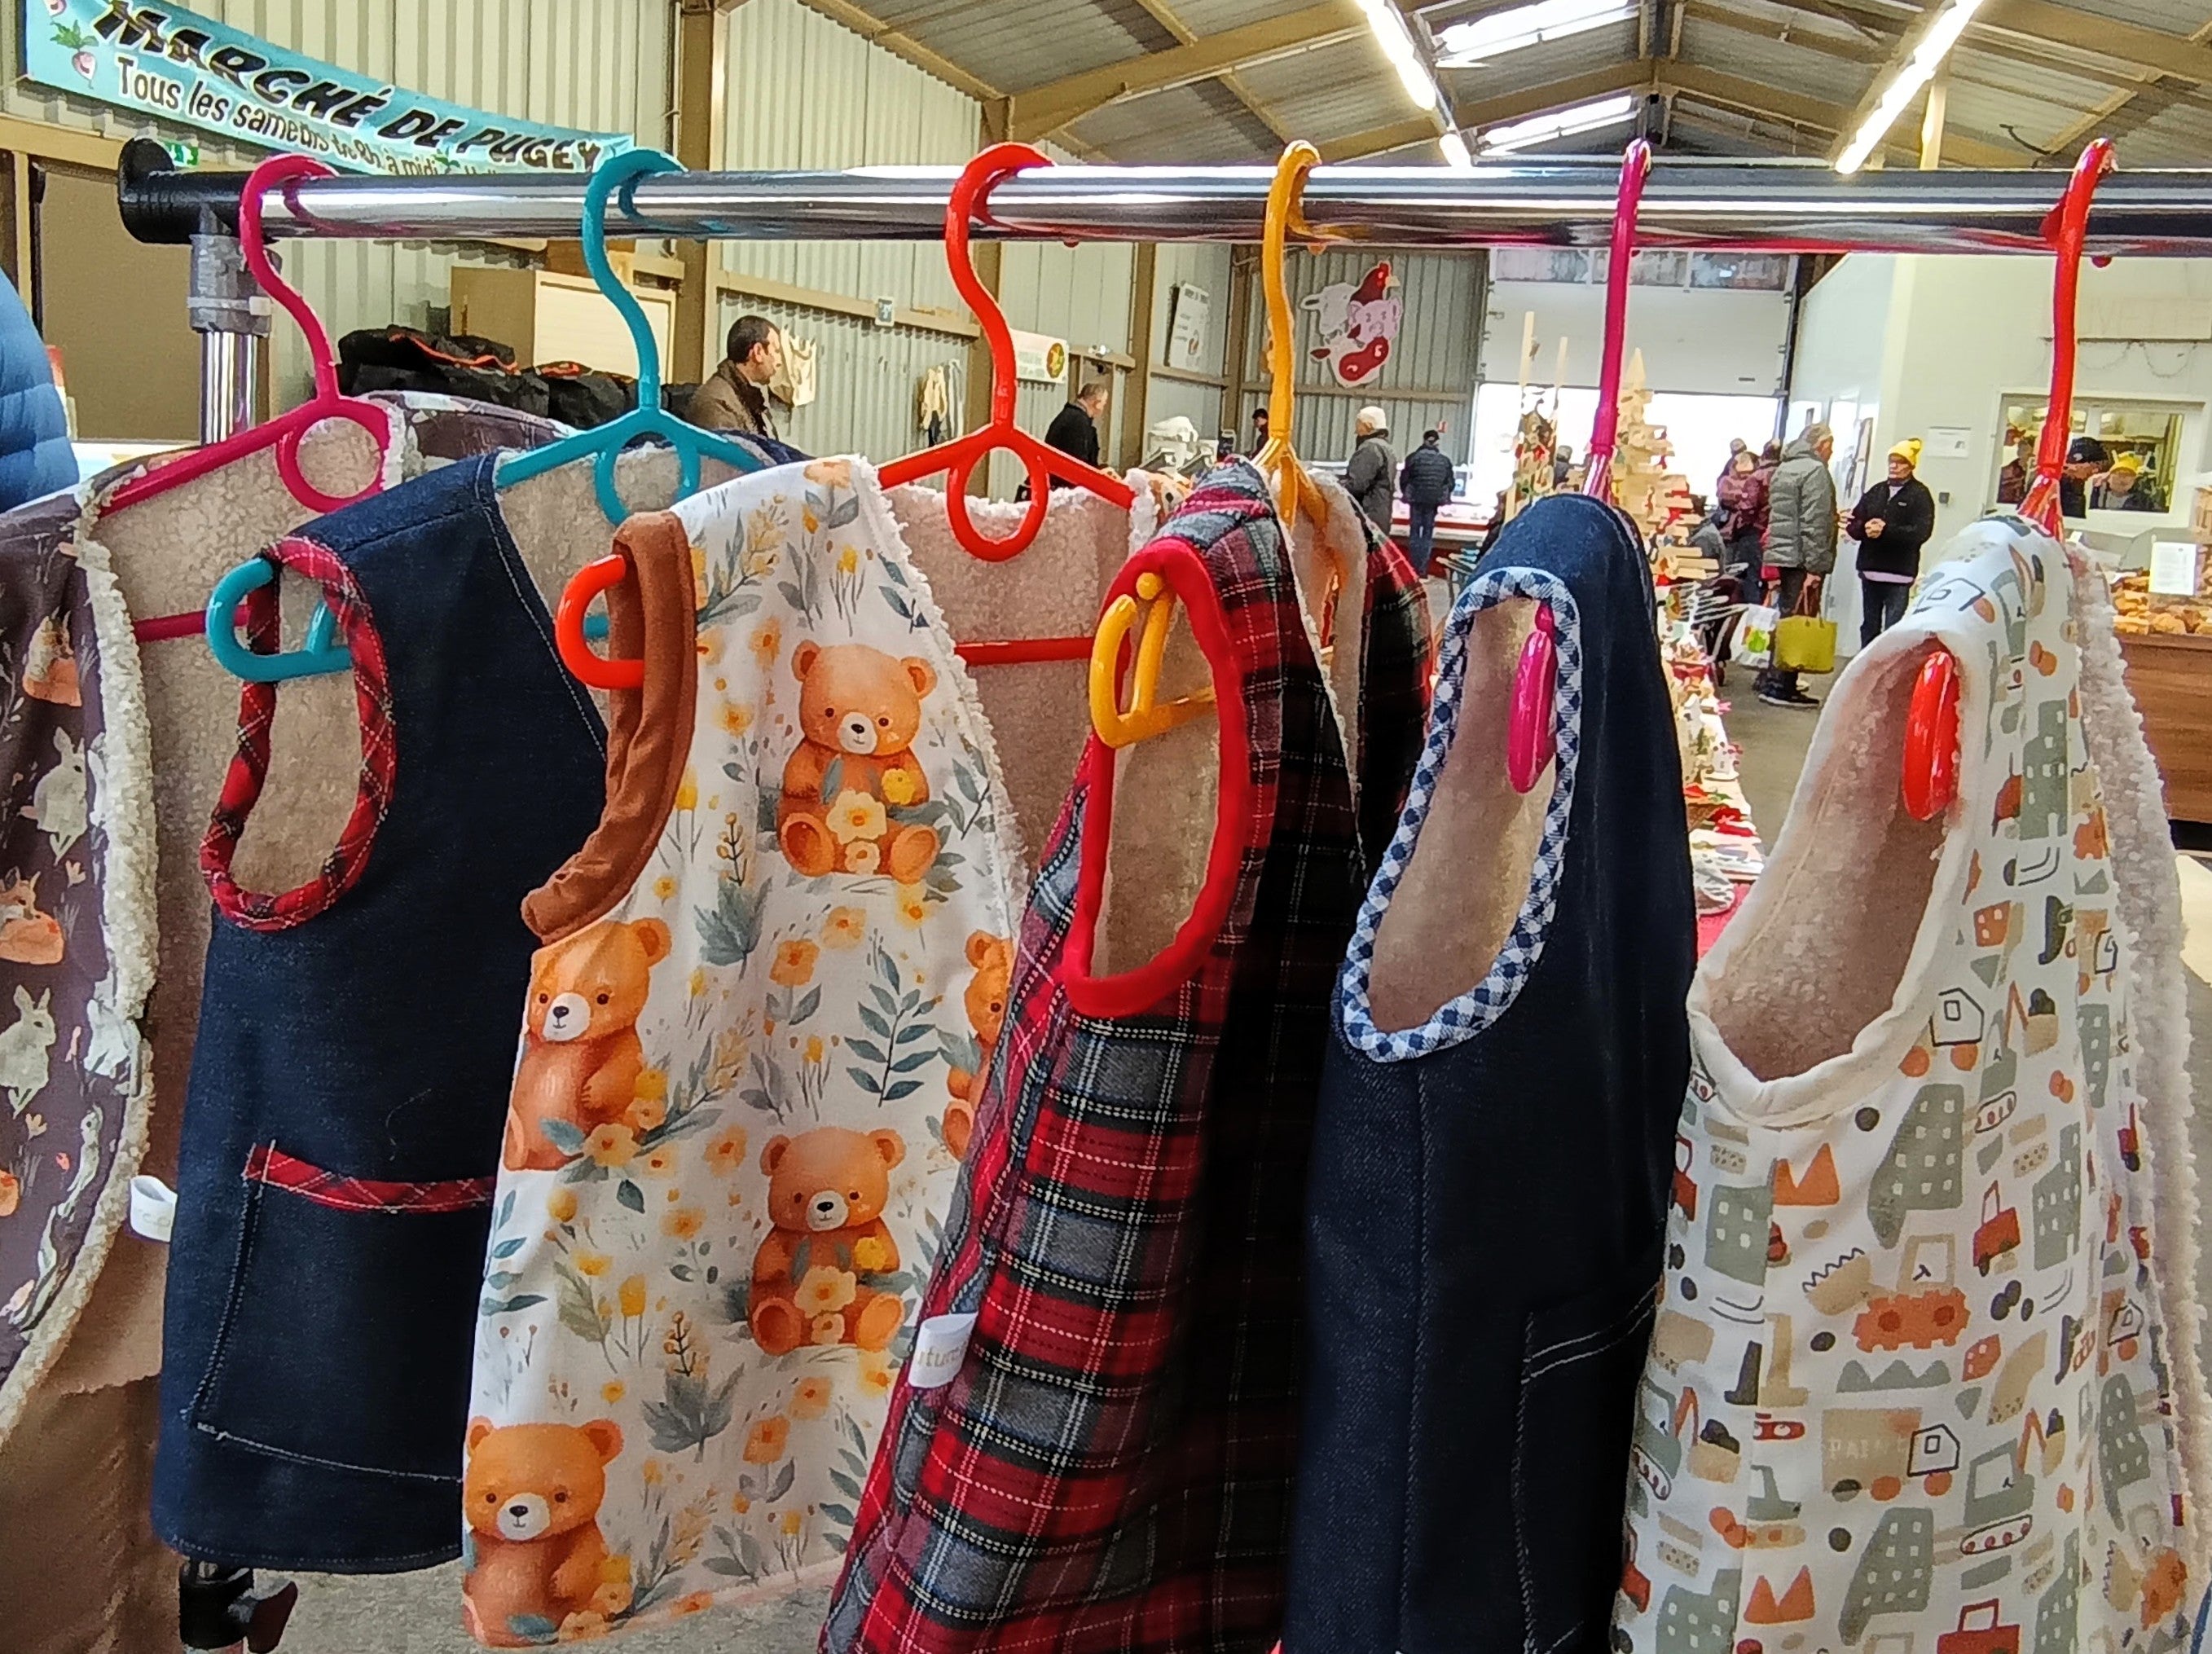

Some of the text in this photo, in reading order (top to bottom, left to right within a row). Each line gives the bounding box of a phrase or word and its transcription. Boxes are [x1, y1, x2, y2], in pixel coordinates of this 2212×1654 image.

[93, 0, 601, 173] MARCHÉ DE PUGEY
[117, 56, 182, 110] Tous
[188, 81, 230, 122] les
